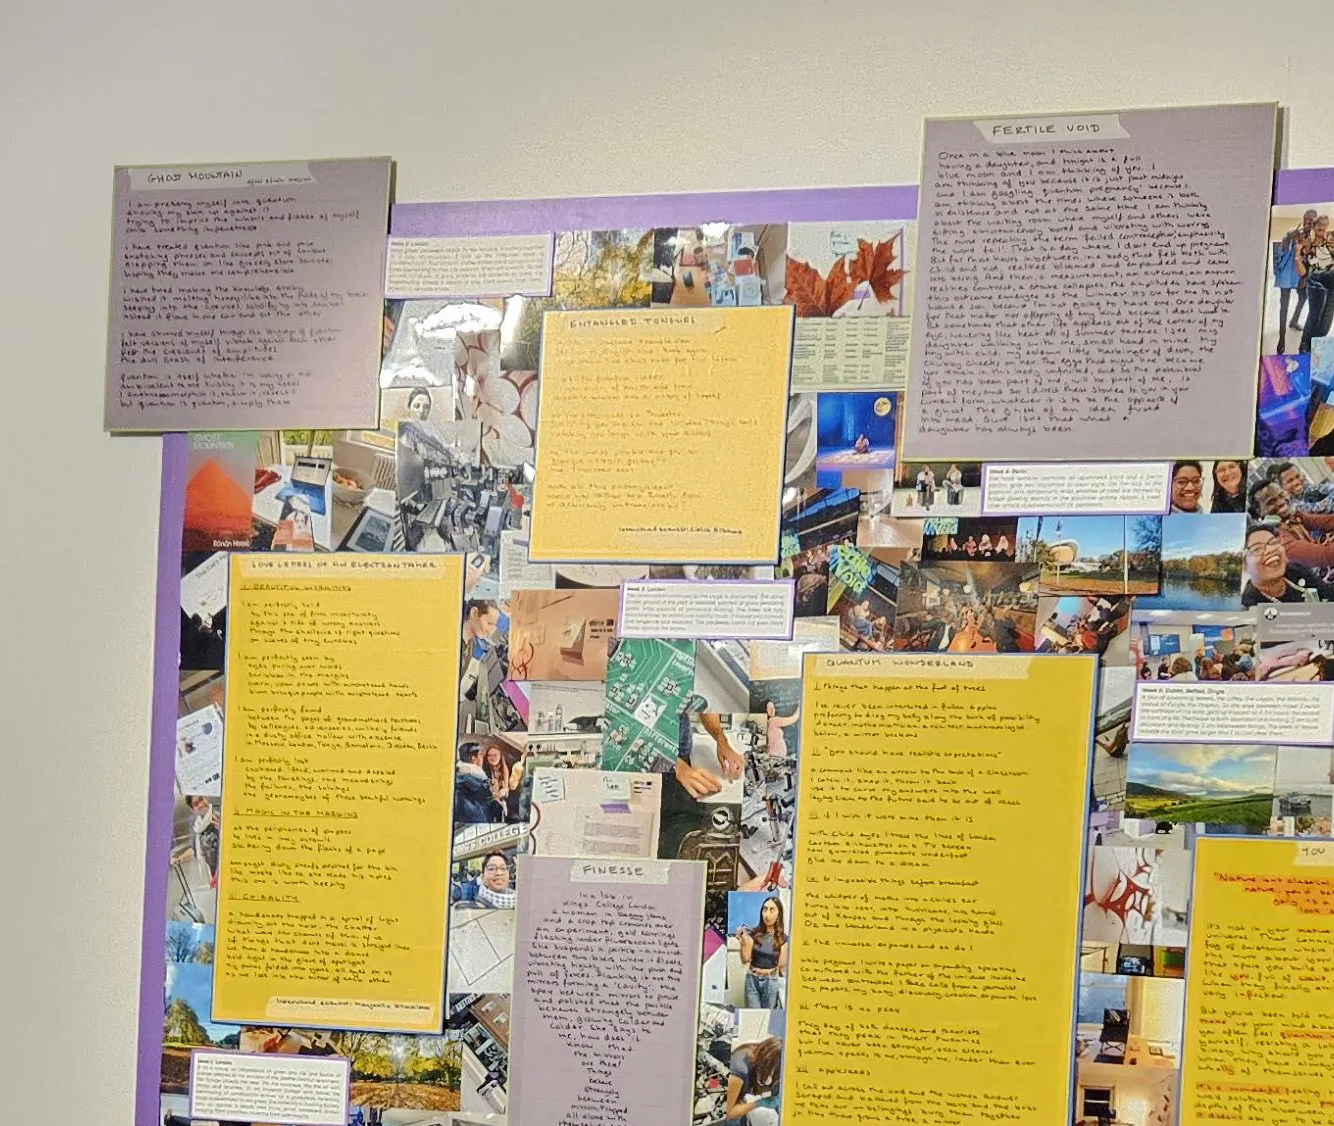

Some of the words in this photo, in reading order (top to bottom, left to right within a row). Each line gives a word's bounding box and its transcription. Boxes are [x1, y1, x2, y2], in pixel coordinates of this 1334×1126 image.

[993, 124, 1055, 135] FERTILE
[1067, 124, 1100, 132] VOID
[148, 174, 181, 183] GHOST
[189, 171, 243, 180] MOUNTAIN
[570, 318, 637, 328] ENTANGLED
[827, 659, 882, 667] QUANTUM
[892, 659, 975, 668] WONDERLAND
[1302, 847, 1325, 856] YOU
[583, 864, 644, 876] FINESSE
